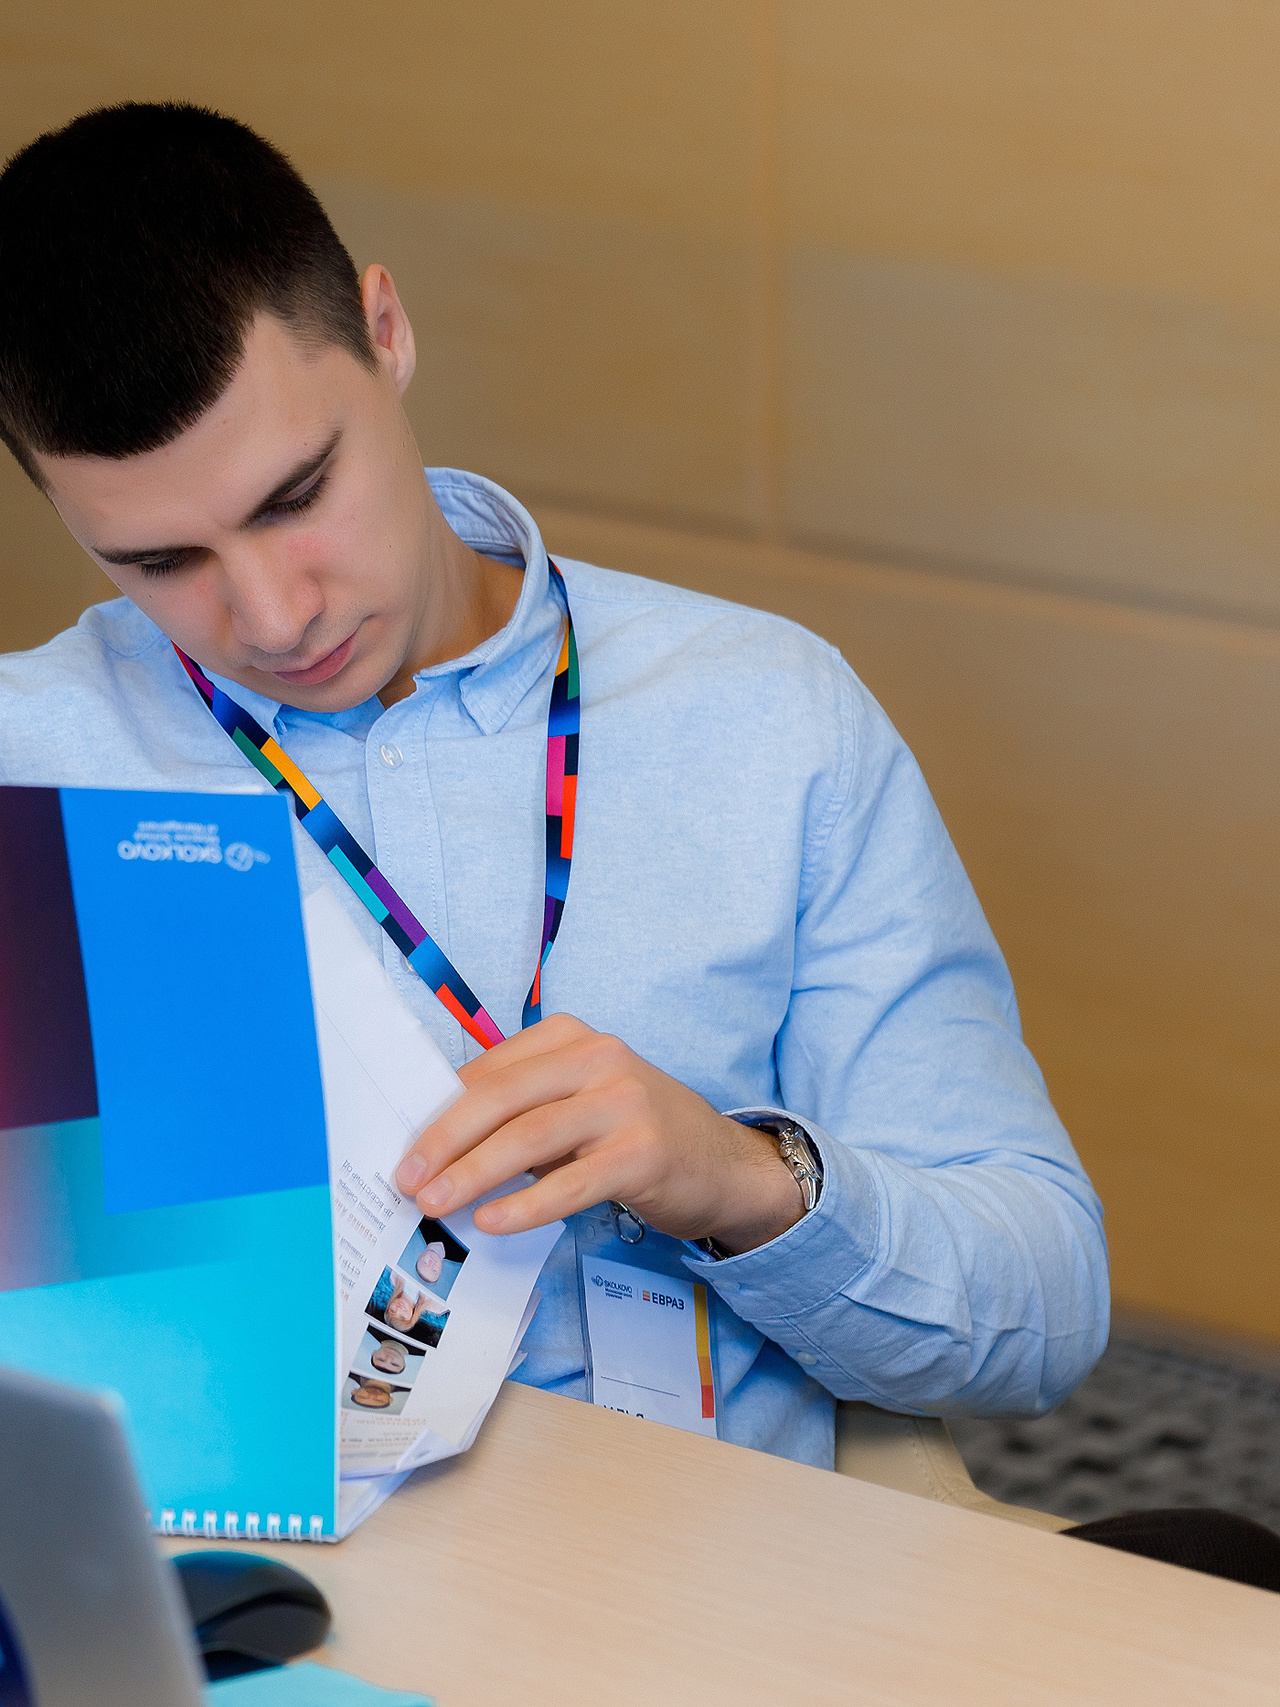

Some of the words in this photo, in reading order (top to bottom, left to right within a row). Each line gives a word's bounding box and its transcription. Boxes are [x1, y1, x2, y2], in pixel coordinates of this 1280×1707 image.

[375, 1171, 402, 1204] Менеджер
[604, 1280, 632, 1293] SKOLKOVO
[652, 1292, 684, 1310] ЕВРАЗ
